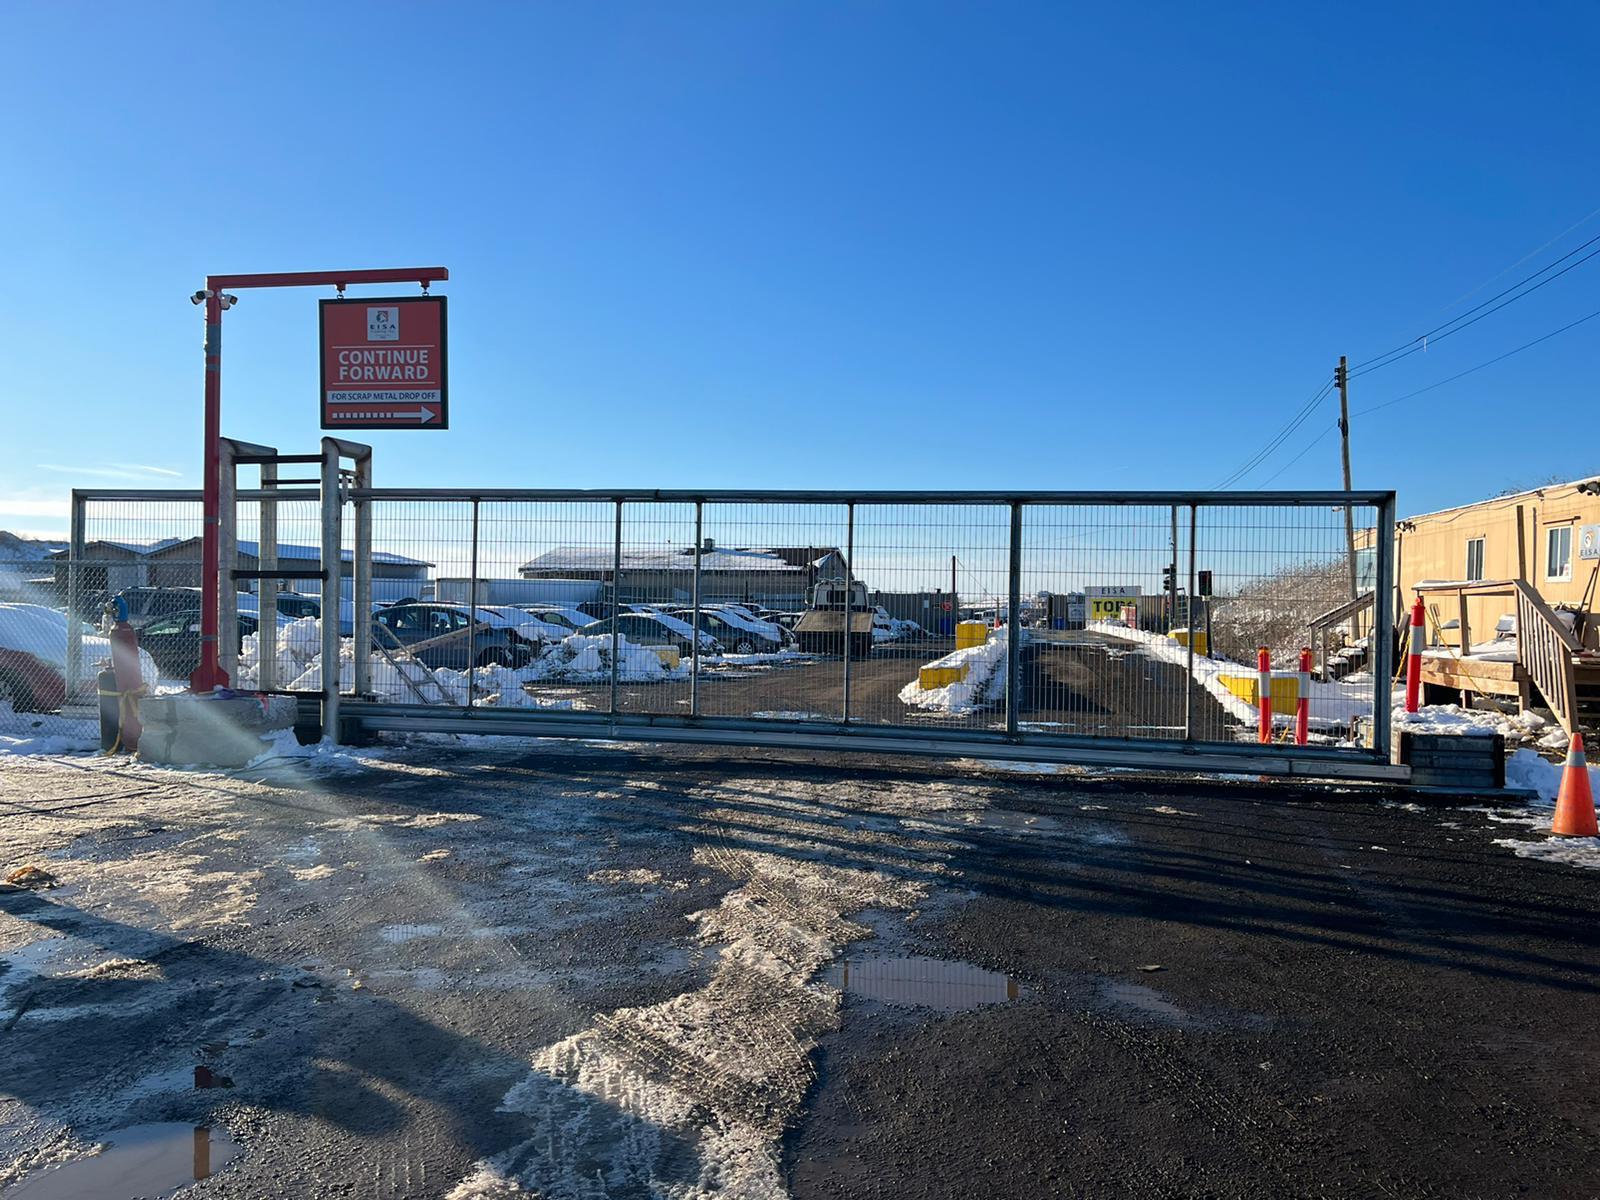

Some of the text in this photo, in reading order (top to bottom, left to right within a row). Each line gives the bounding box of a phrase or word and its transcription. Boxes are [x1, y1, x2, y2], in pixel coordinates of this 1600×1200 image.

[339, 350, 428, 364] CONTINUE
[339, 366, 428, 380] FORWARD
[331, 391, 436, 400] FOR SCRAP METAL DROP OFF
[1580, 548, 1598, 556] EISA
